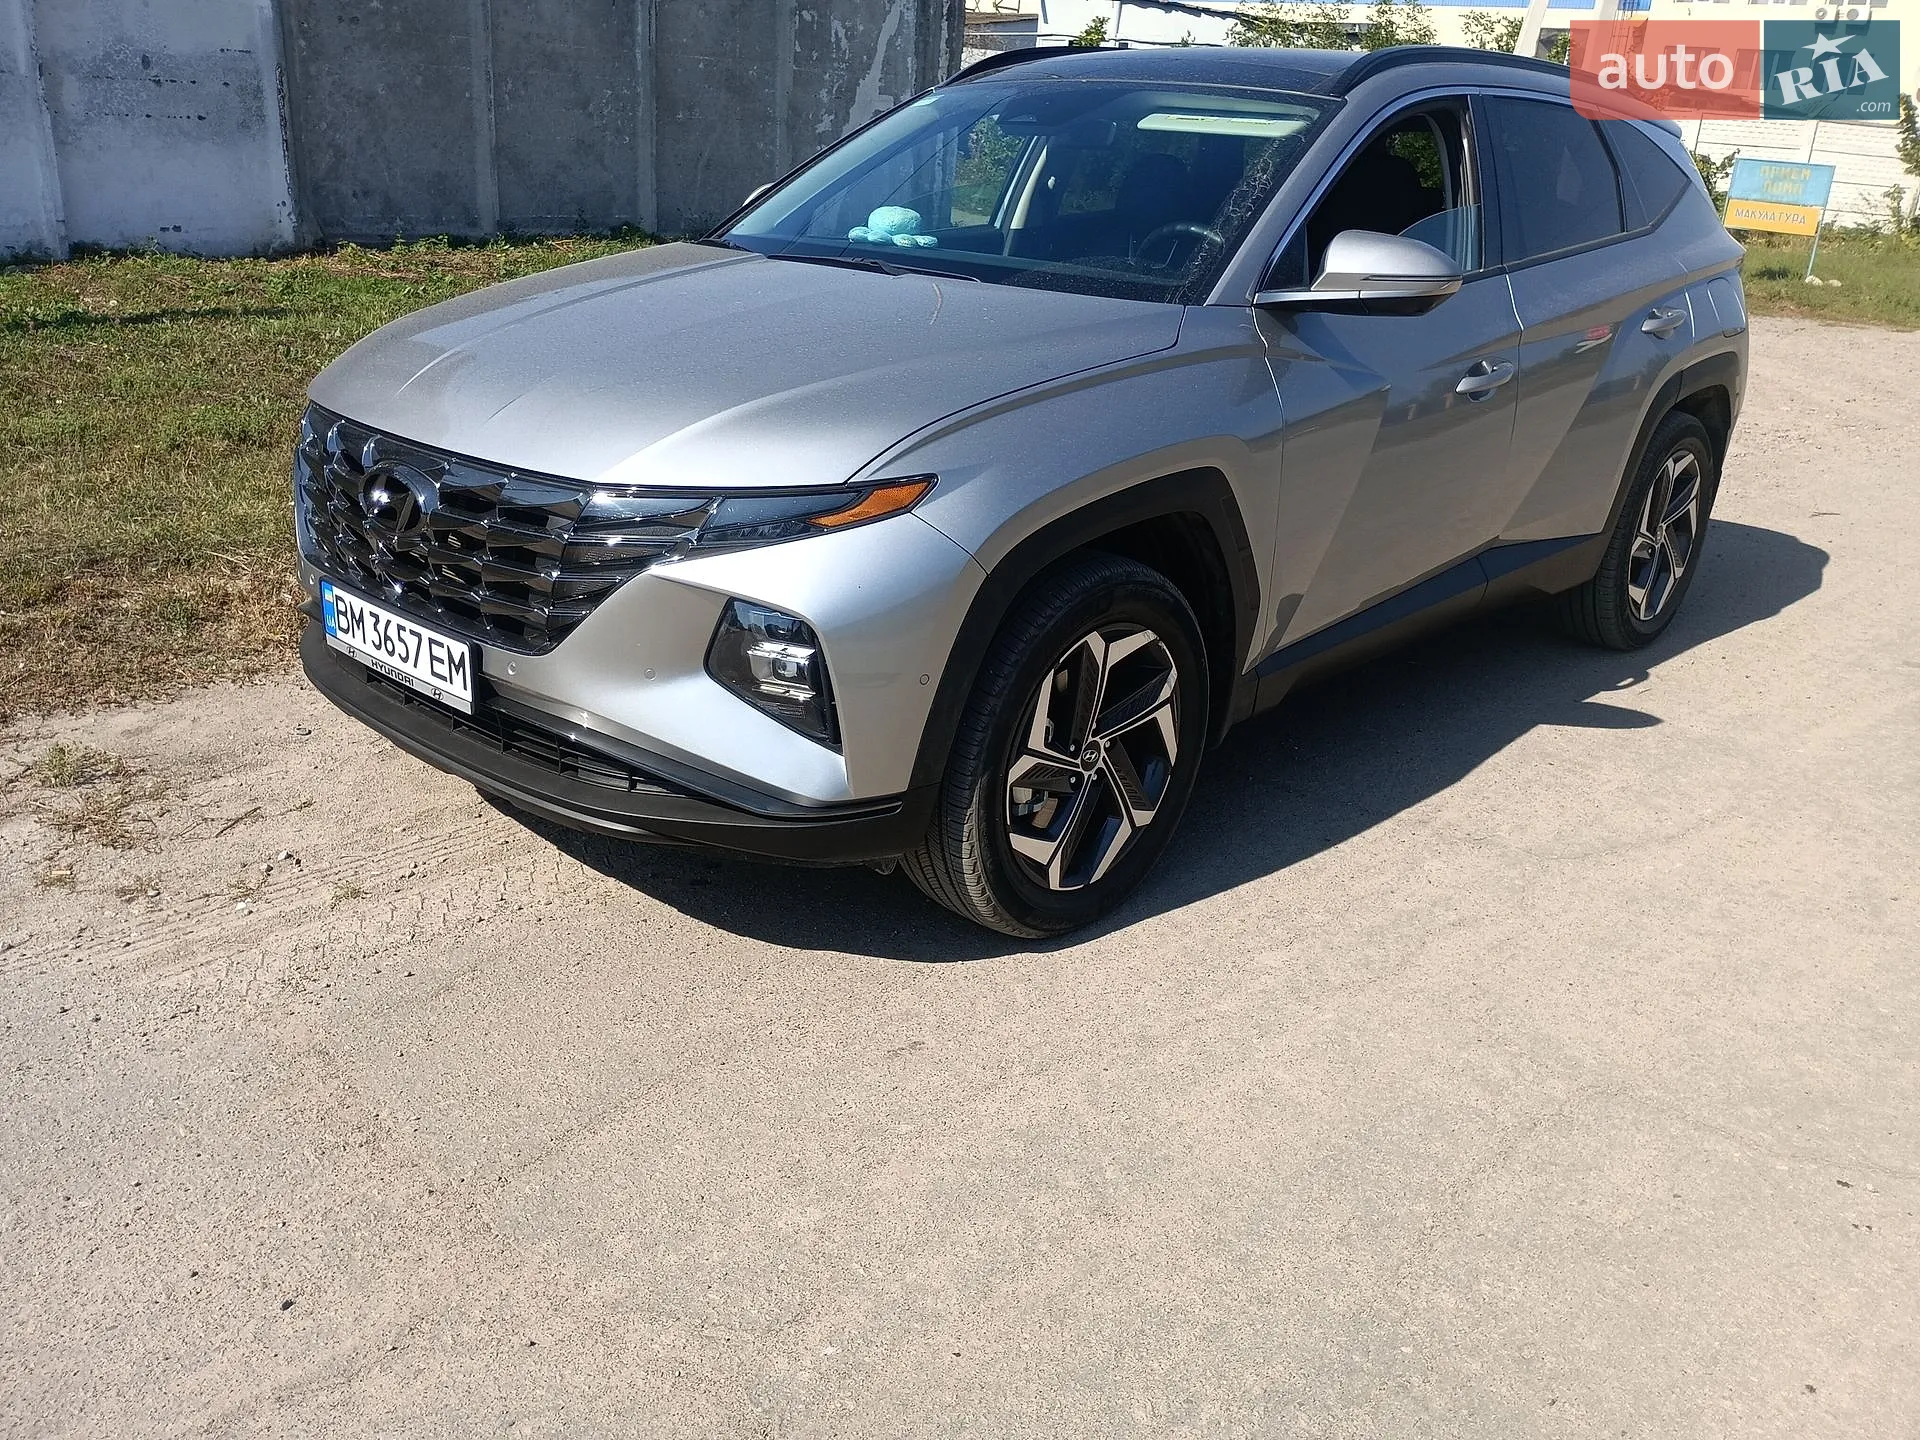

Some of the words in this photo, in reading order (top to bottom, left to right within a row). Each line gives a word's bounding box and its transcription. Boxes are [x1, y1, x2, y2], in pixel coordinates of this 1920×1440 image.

[1735, 207, 1806, 225] МАКУЛАТУРА
[326, 613, 336, 629] UA
[369, 610, 422, 669] 3657
[428, 637, 468, 691] EM
[371, 659, 415, 687] HYUNDAI
